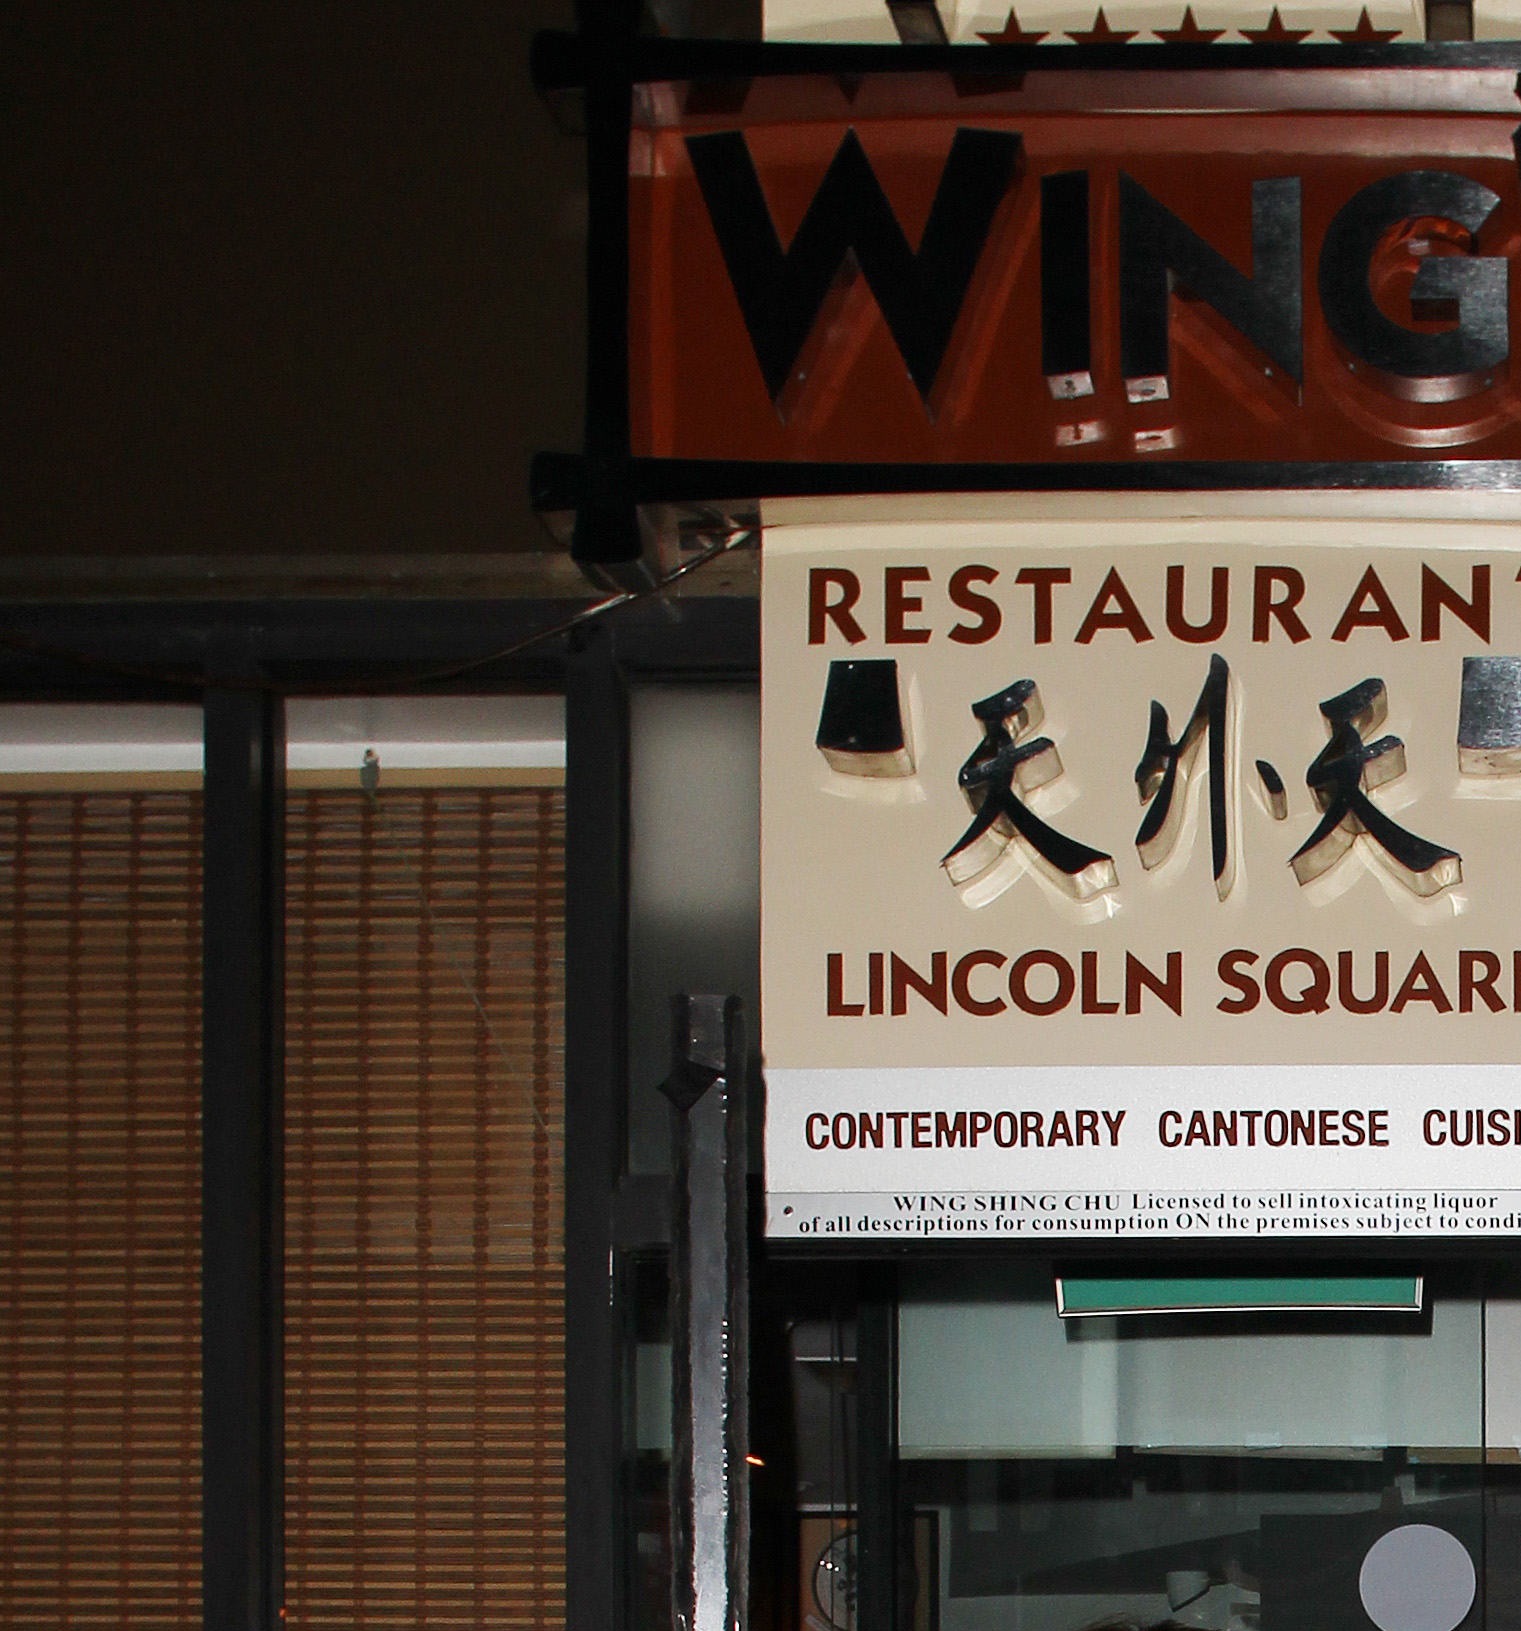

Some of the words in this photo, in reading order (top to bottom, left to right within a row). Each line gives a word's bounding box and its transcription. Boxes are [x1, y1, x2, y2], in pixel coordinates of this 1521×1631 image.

[826, 949, 1183, 1017] LINCOLN
[805, 1109, 1126, 1150] CONTEMPORARY
[1158, 1109, 1390, 1148] CANTONESE
[893, 1195, 966, 1212] WING
[974, 1195, 1057, 1211] SHING
[1064, 1195, 1120, 1211] CHU
[1132, 1193, 1225, 1210] Licensed
[1232, 1195, 1252, 1209] to
[1258, 1192, 1292, 1209] sell
[1299, 1192, 1427, 1212] intoxicating
[1433, 1192, 1498, 1212] liquor
[799, 1215, 821, 1232] of
[825, 1215, 851, 1232] all
[857, 1214, 988, 1235] descriptions
[995, 1214, 1026, 1231] for
[1031, 1213, 1169, 1234] consumption
[1176, 1212, 1210, 1229] ON
[1217, 1212, 1249, 1229] the
[1256, 1212, 1350, 1233] premises
[1356, 1212, 1432, 1233] subject
[1439, 1213, 1459, 1229] to
